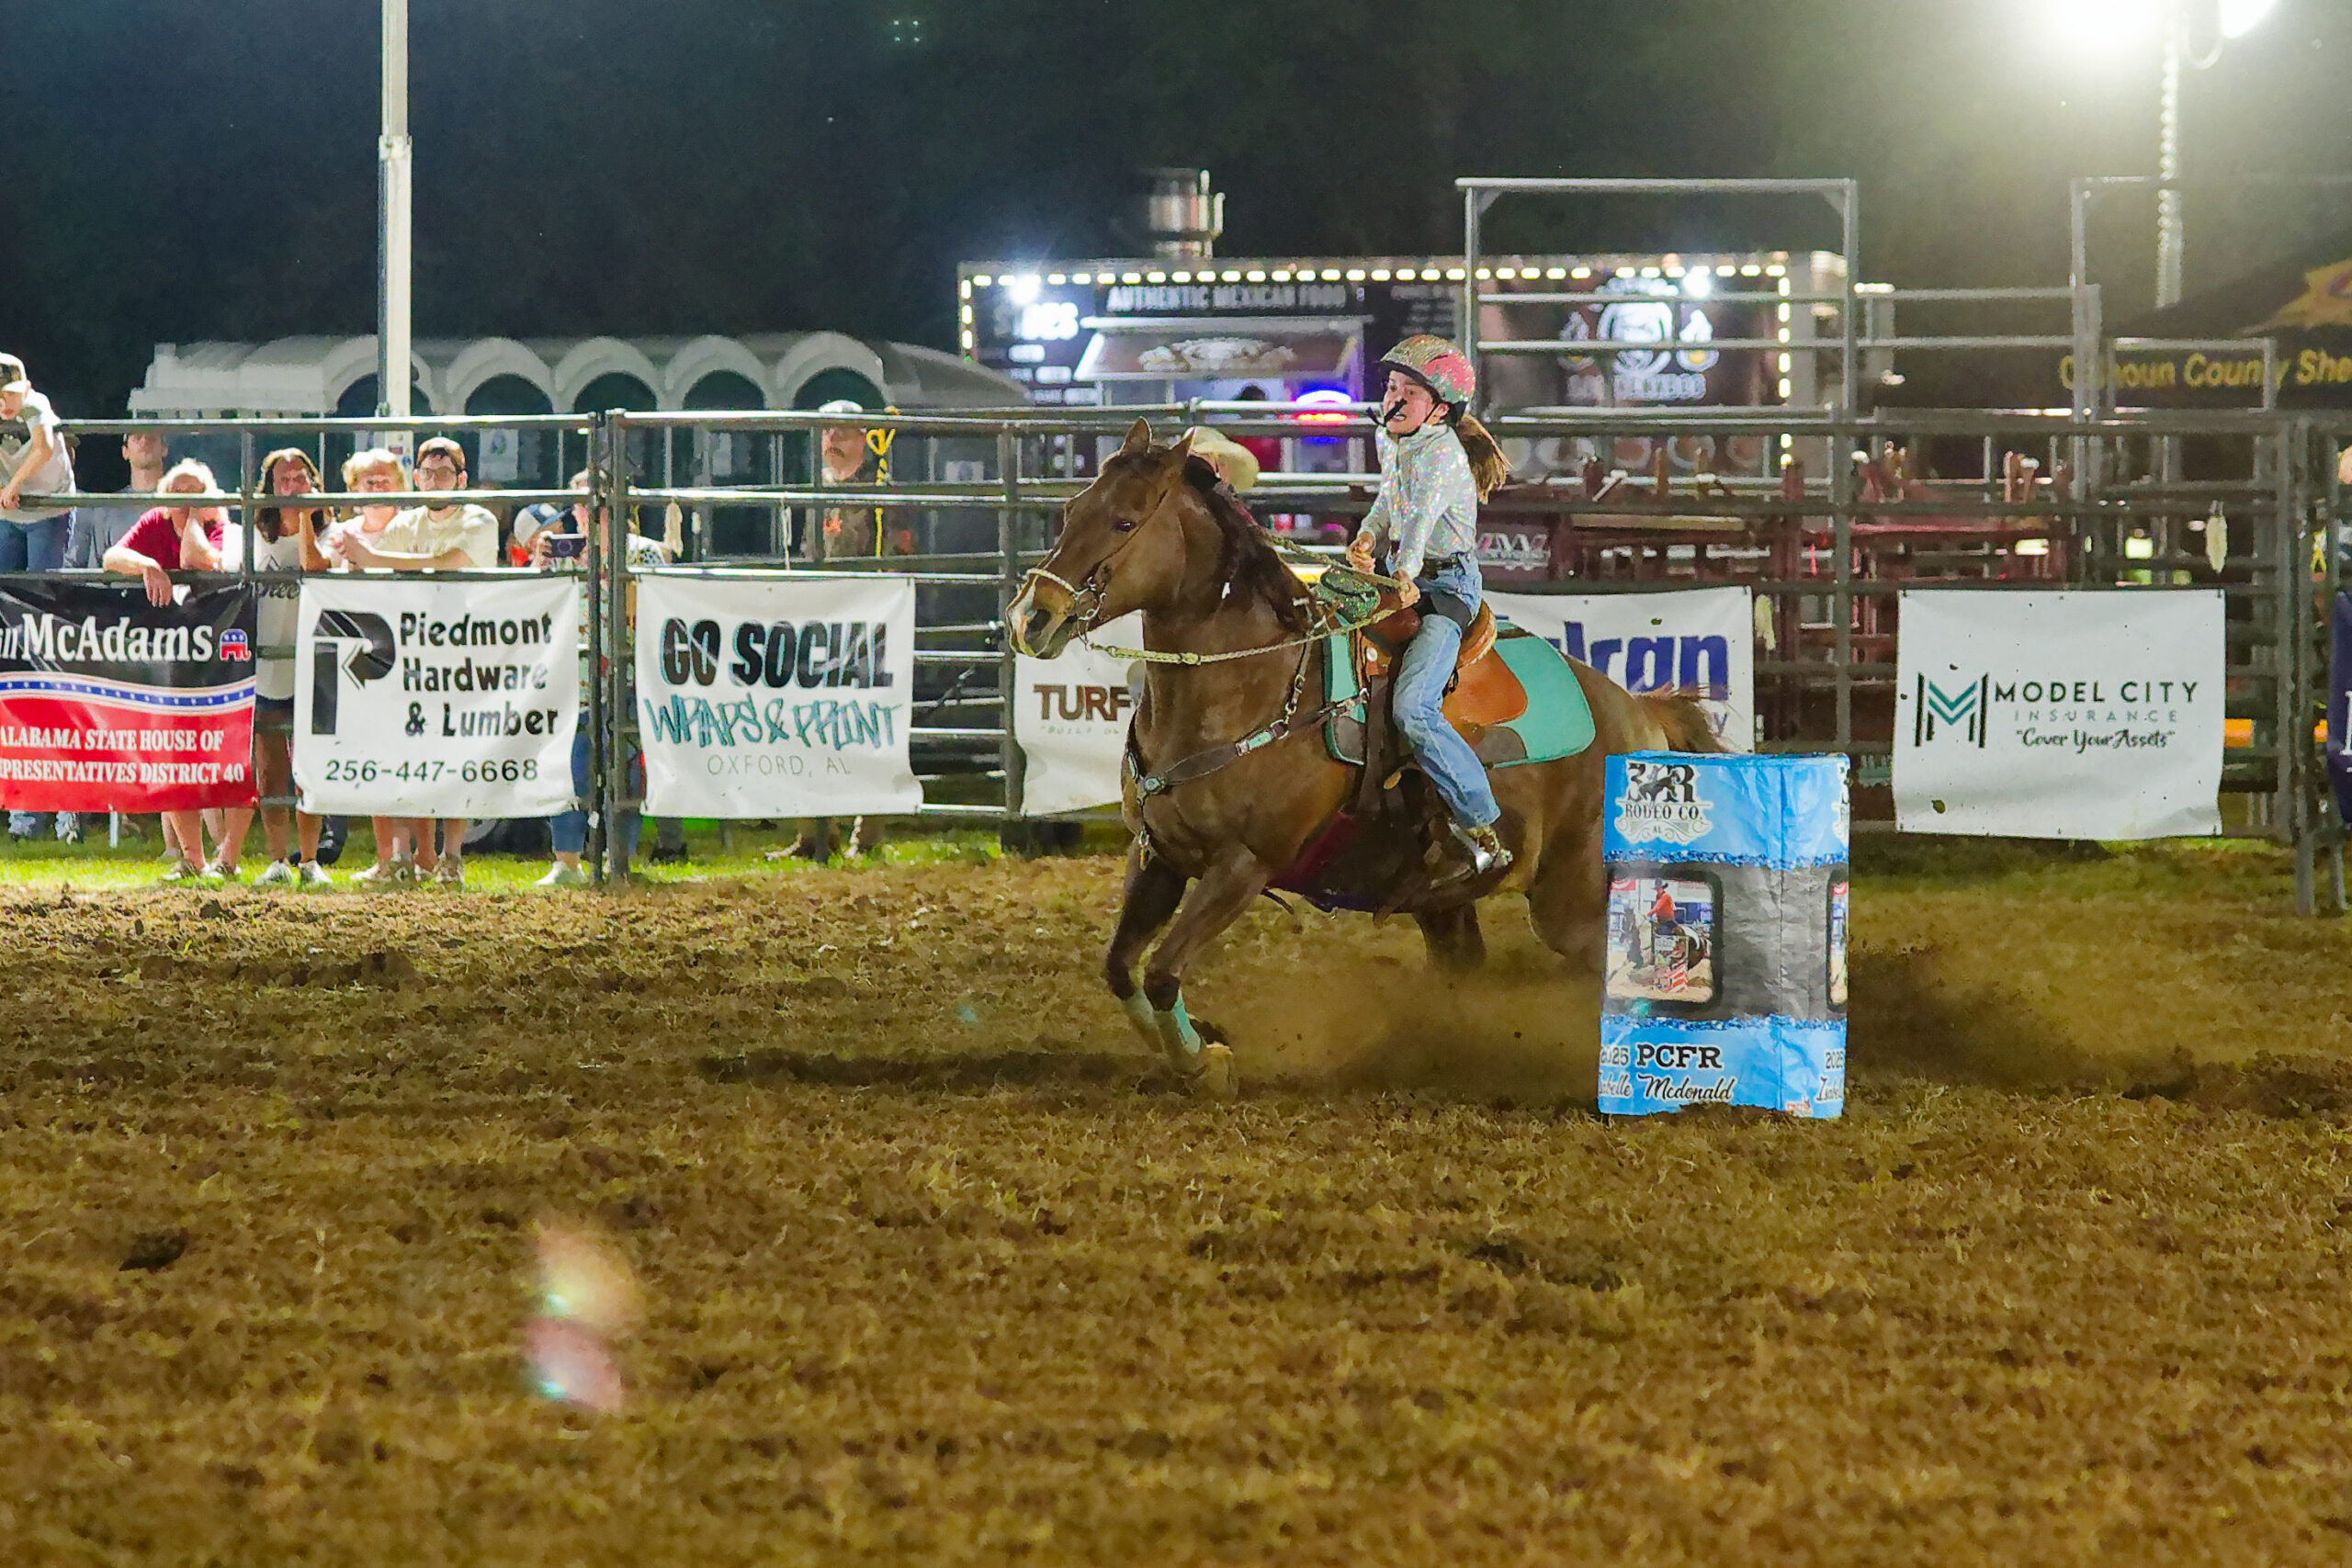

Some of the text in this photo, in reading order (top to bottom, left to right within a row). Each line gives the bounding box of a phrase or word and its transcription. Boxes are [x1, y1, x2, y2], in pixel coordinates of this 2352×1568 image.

[2183, 352, 2290, 388] Couny
[22, 613, 213, 662] McAdams
[400, 612, 552, 647] Piedmont
[659, 616, 895, 690] GO SOCIAL
[402, 656, 548, 692] Hardware
[1033, 683, 1133, 722] TURF
[1995, 681, 2199, 704] MODEL CITY
[405, 700, 559, 738] & Lumber
[644, 693, 763, 749] WRAPS
[792, 699, 903, 751] PRINT
[2014, 709, 2177, 723] INSURANCE
[0, 726, 224, 751] ALABAMA STATE HOUSE OF
[2072, 728, 2114, 755] Your
[0, 756, 244, 784] PRESENTATIVES DISTRICT 40
[324, 759, 538, 782] 256-447-6668
[707, 754, 852, 778] OXFORD, AL
[1625, 803, 1703, 822] RODEO CO.
[1636, 1043, 1724, 1069] PCFR
[1637, 1073, 1736, 1100] Mcdonald
